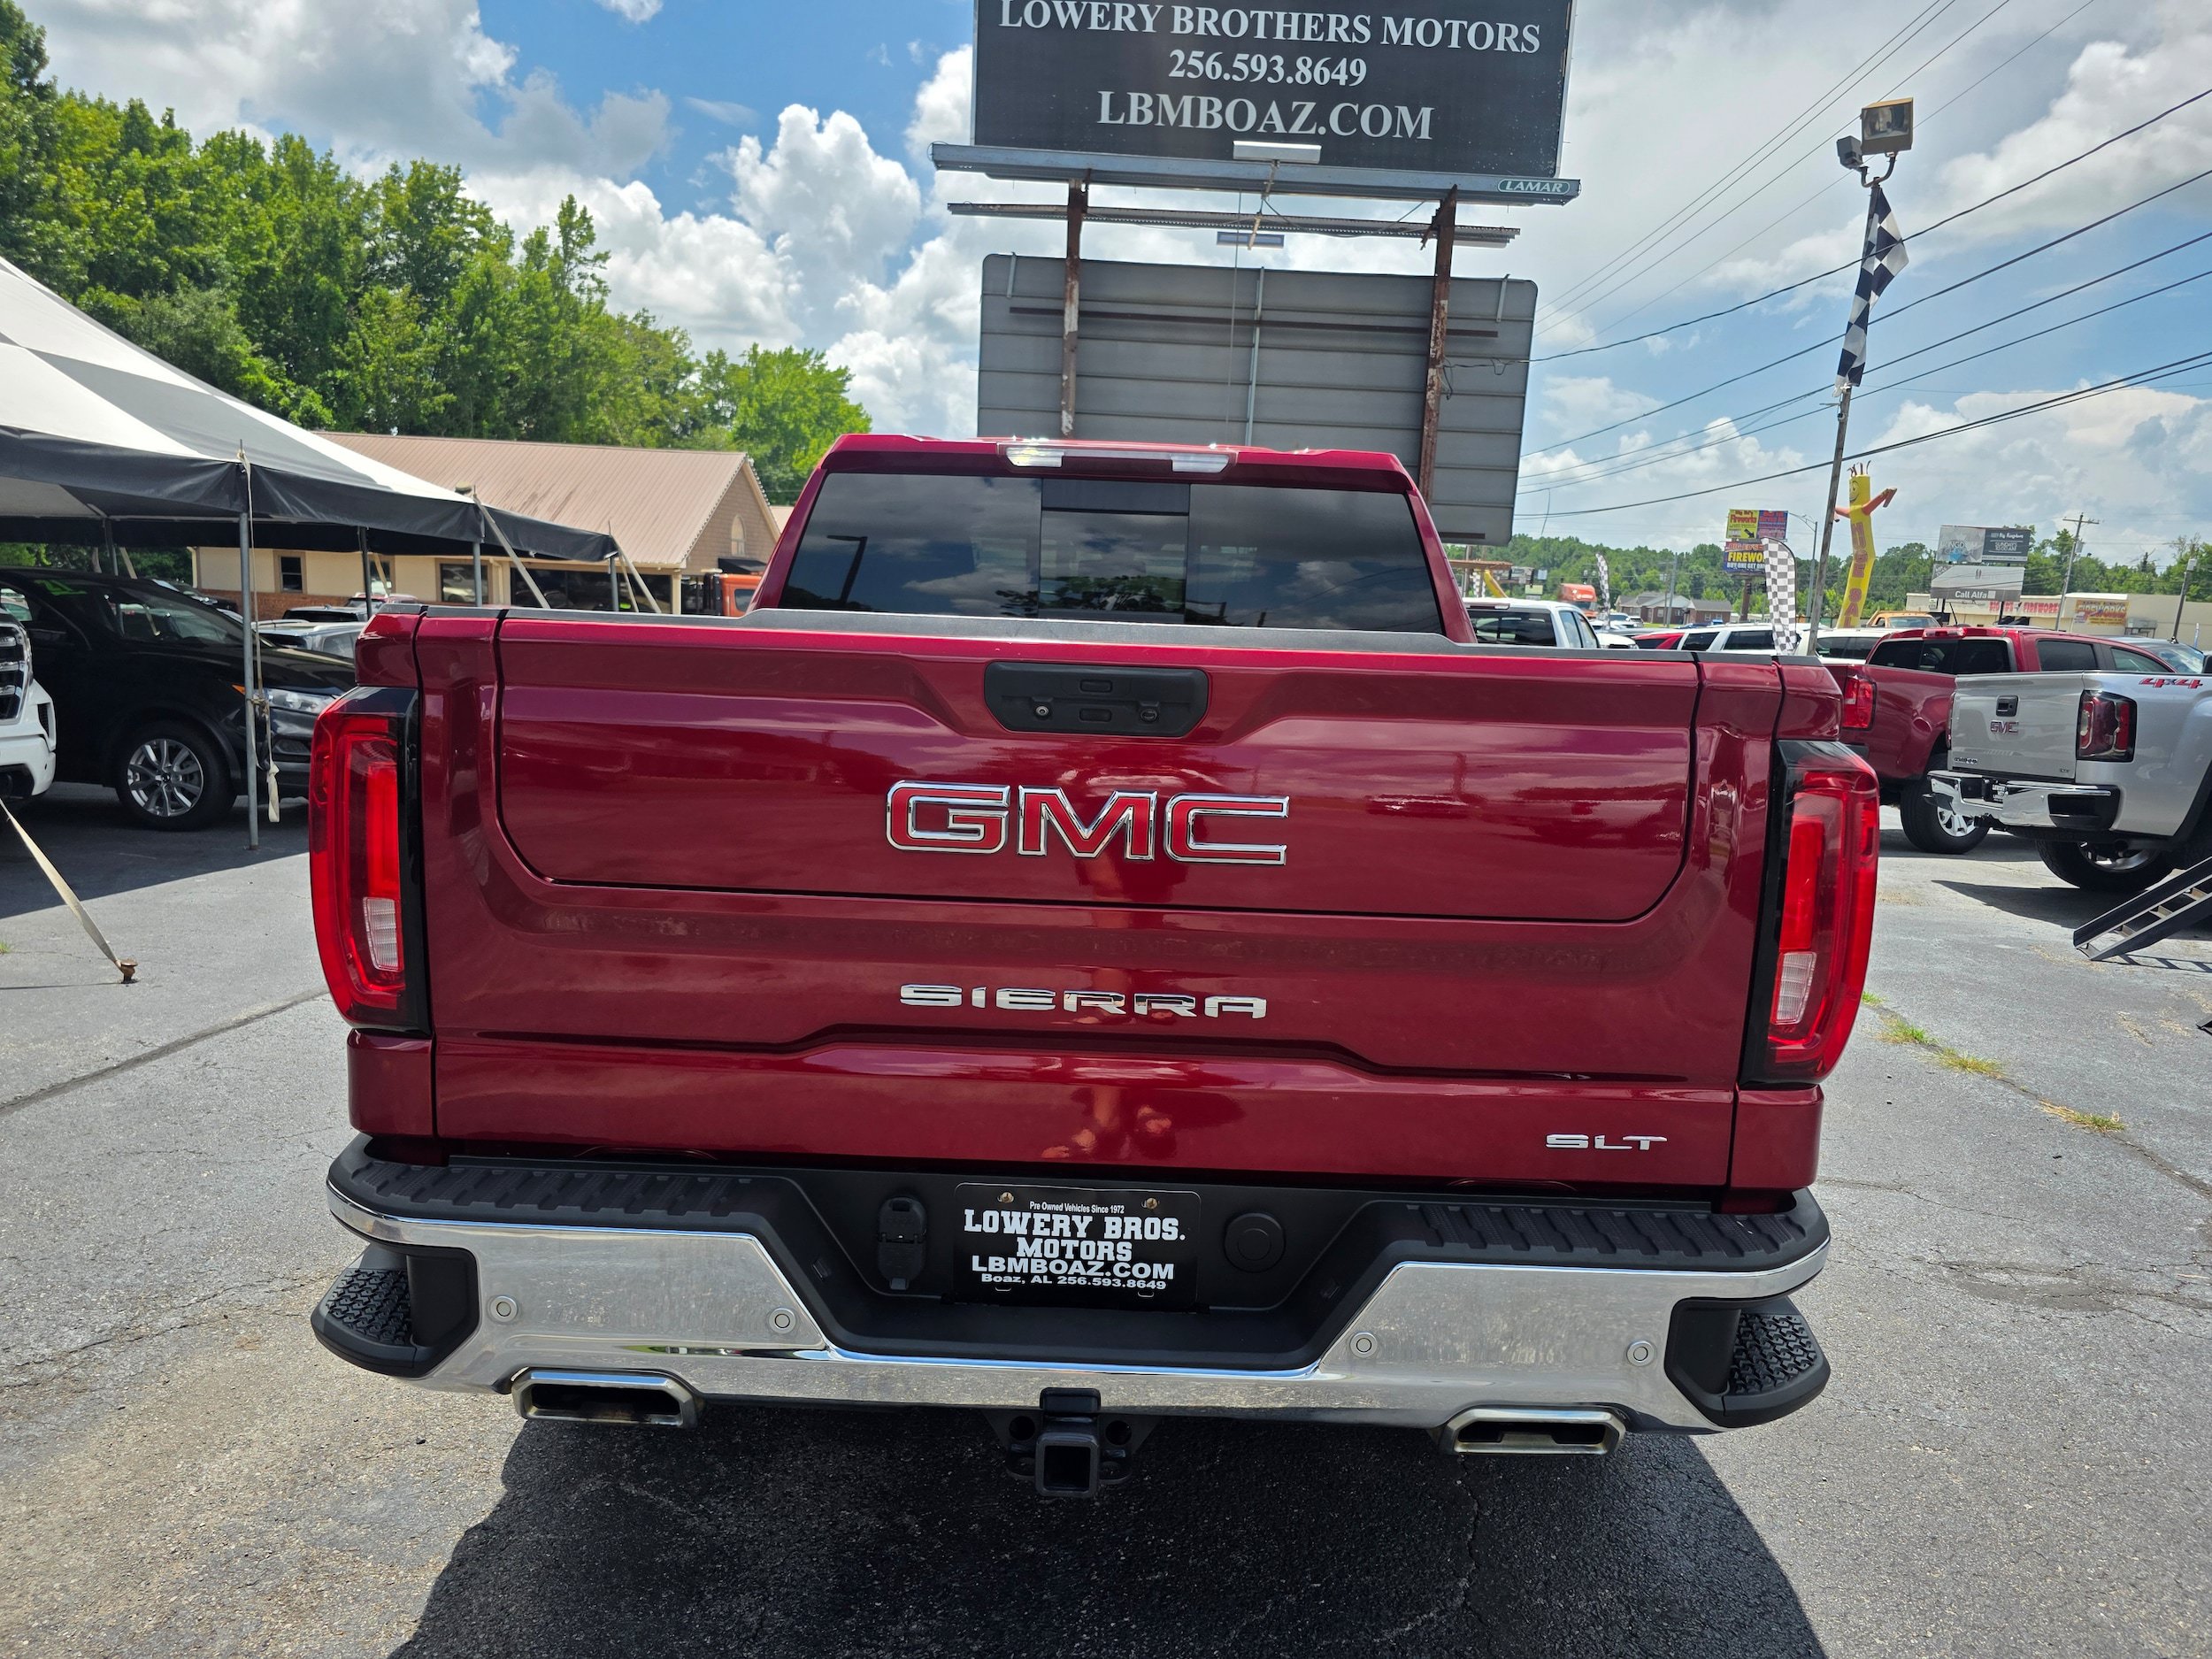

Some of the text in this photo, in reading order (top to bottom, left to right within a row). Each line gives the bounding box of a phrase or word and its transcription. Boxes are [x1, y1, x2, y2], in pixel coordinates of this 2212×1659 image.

[998, 0, 1541, 54] LOWERY BROTHERS MOTORS
[1168, 49, 1367, 87] 256.593.8649
[1097, 90, 1434, 140] LBMBOAZ.COM
[1505, 180, 1563, 192] LAMAR
[1990, 720, 2019, 734] GMC
[886, 780, 1290, 866] GMC
[899, 983, 1267, 1019] SIERRA
[1546, 1133, 1668, 1150] SLT
[1029, 1201, 1125, 1214] Pre Owned Vehicles Since 1972
[964, 1209, 1186, 1240] LOWERY BROS.
[1016, 1237, 1133, 1262] MOTORS
[972, 1255, 1174, 1279] LBMBOAZ.COM
[981, 1273, 1167, 1290] Boaz, AL 256.593.8649
